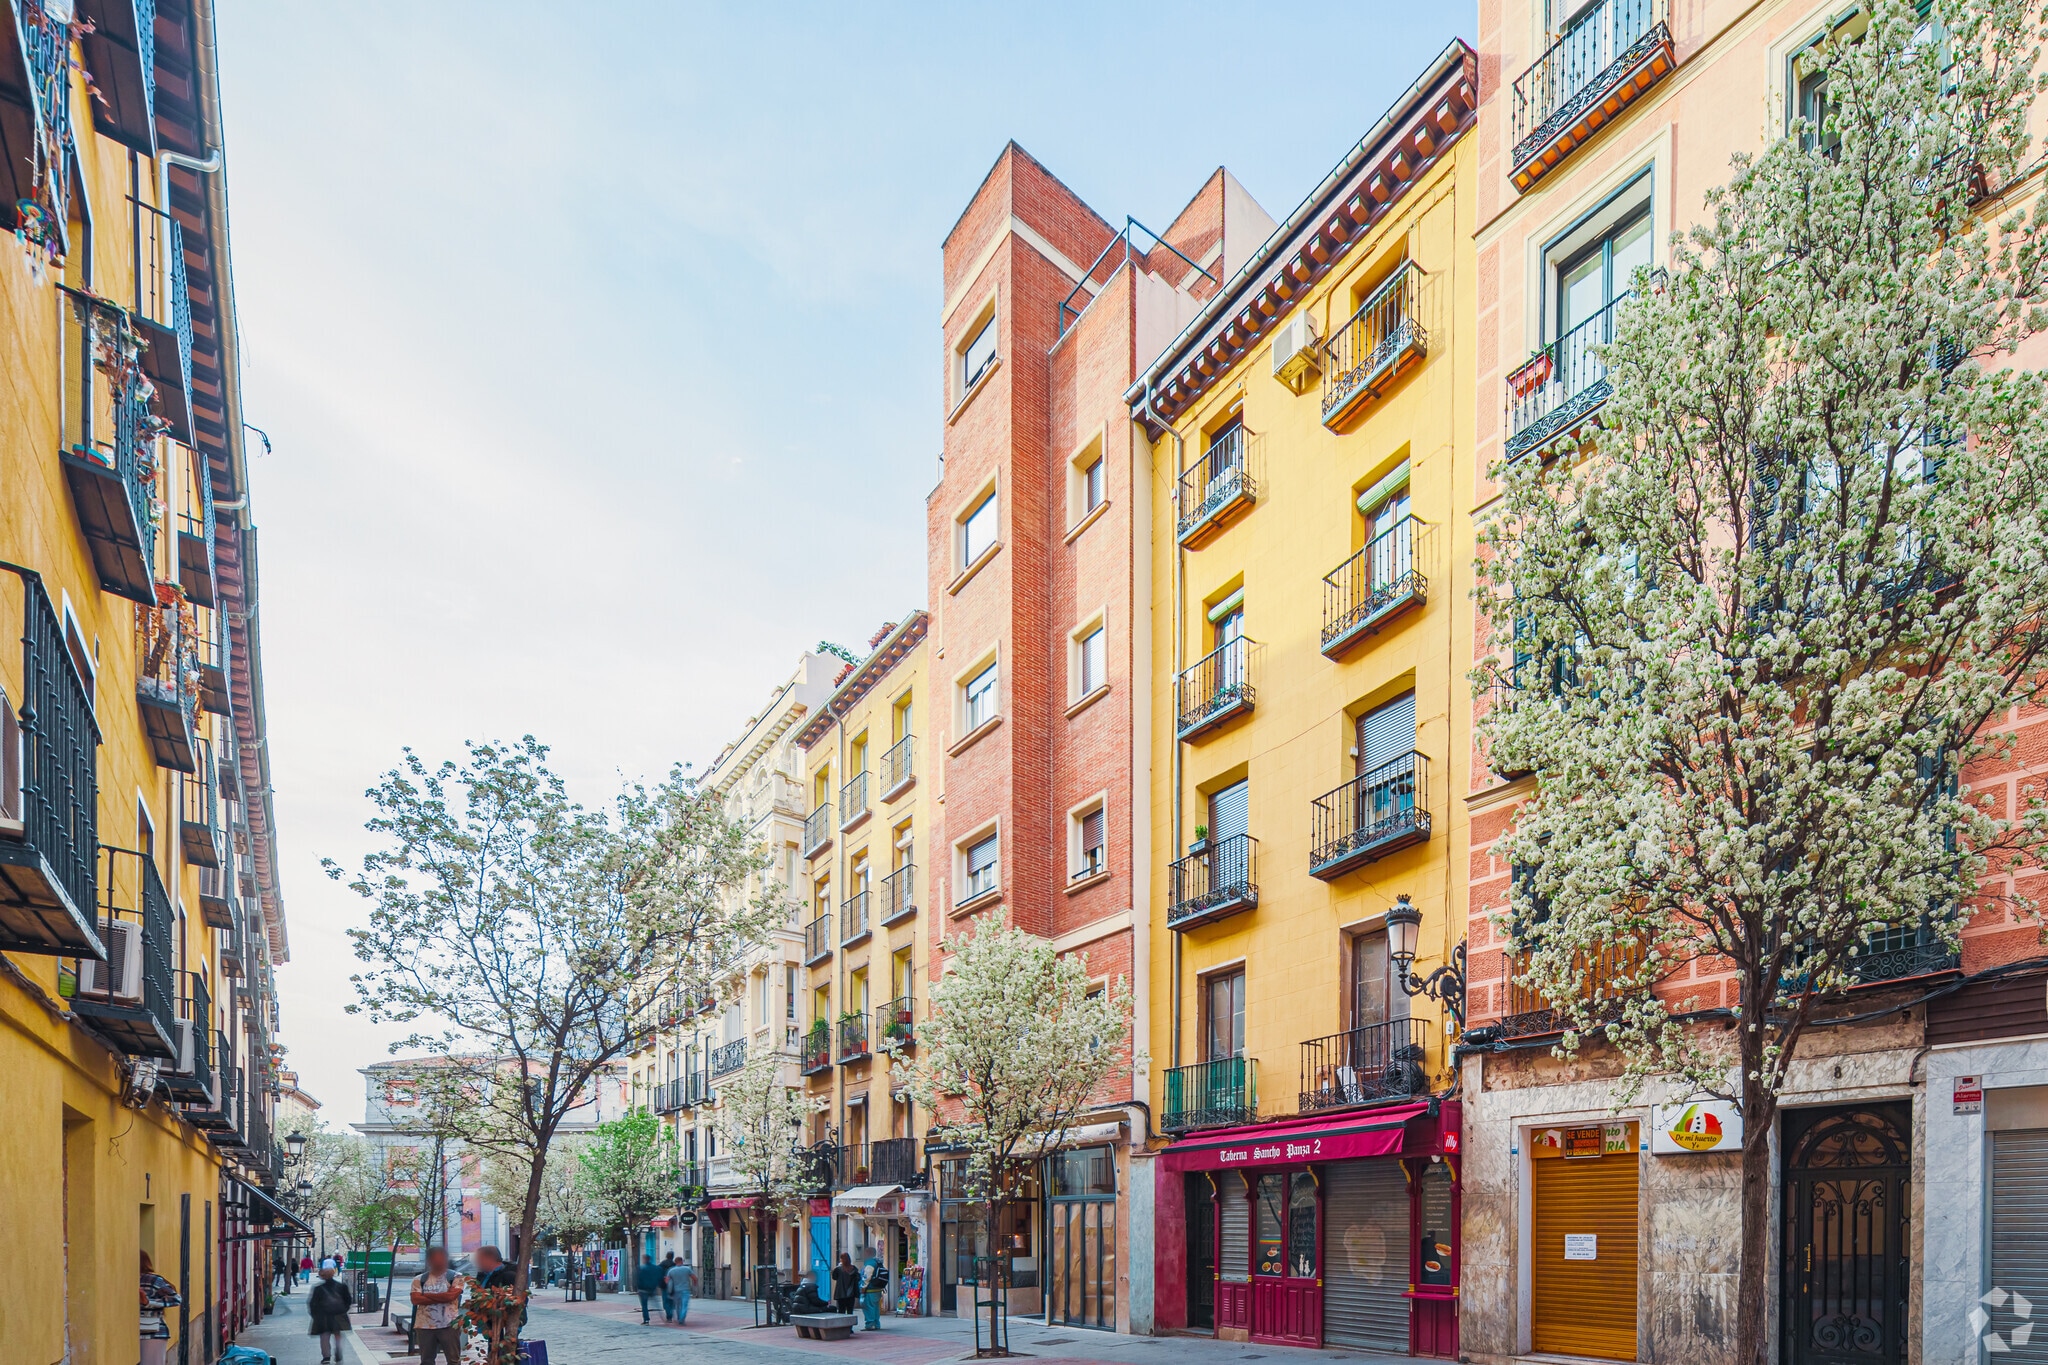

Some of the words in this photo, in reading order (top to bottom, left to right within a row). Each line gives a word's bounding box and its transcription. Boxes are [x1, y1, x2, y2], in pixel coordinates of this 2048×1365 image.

[1834, 1066, 1842, 1079] 8
[1566, 1130, 1575, 1140] SE
[1576, 1129, 1600, 1139] VENDE
[1446, 1135, 1457, 1150] illy
[1606, 1140, 1626, 1152] RIA
[1220, 1150, 1248, 1162] Taberna
[1253, 1146, 1280, 1159] Sancho
[1286, 1144, 1310, 1158] Panza
[1313, 1139, 1321, 1154] 2
